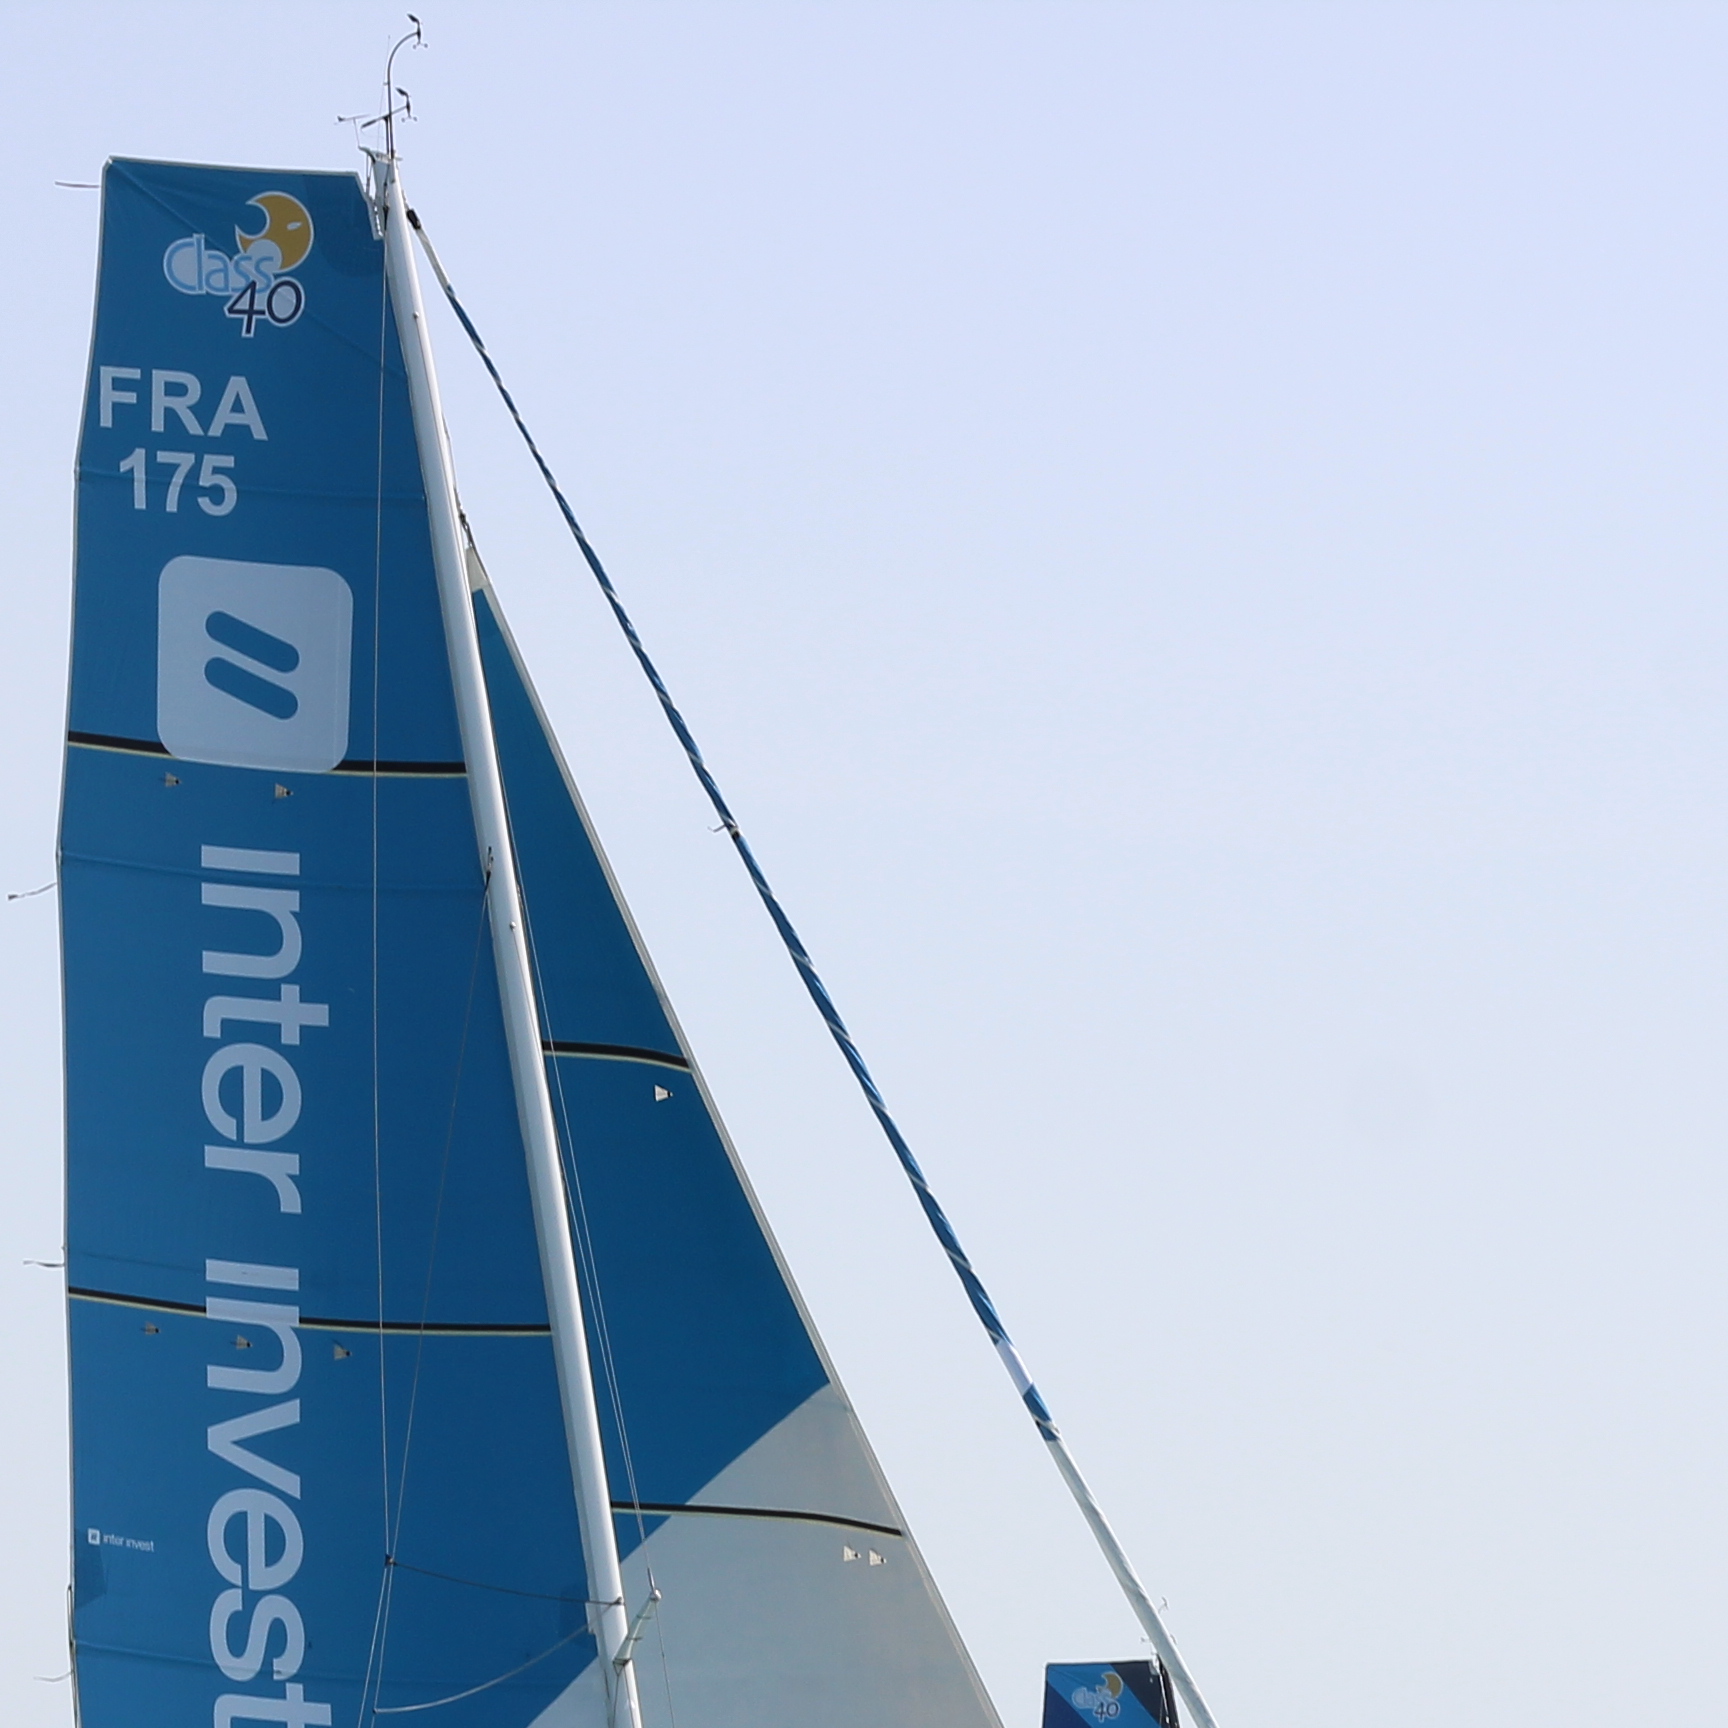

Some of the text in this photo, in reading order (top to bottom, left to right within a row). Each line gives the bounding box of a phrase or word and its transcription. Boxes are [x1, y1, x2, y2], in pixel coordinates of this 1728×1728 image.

[164, 233, 276, 296] Class
[224, 276, 306, 338] 40
[99, 365, 269, 442] FRA
[119, 447, 238, 517] 175
[201, 844, 330, 1214] inter
[1093, 1701, 1121, 1722] 40
